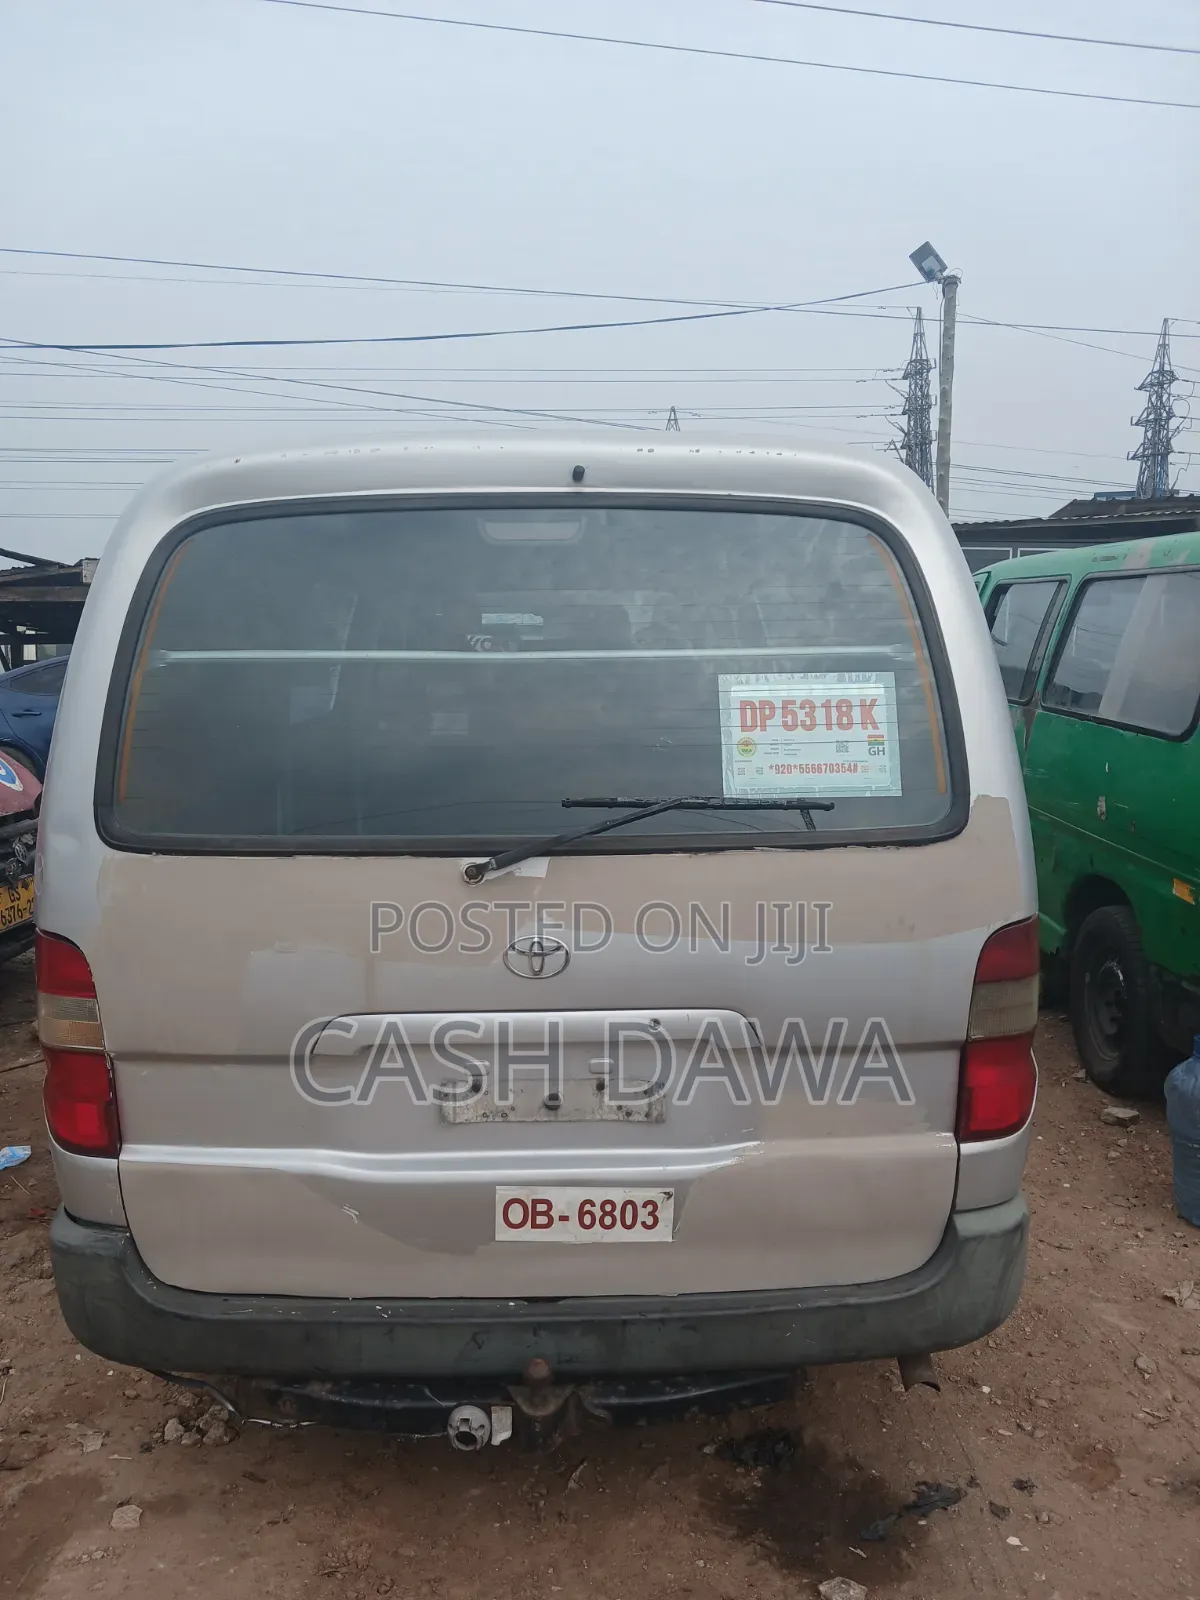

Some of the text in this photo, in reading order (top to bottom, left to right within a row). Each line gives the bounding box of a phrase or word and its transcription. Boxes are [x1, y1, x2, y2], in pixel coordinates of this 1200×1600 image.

[739, 698, 880, 733] DP 5318 K
[868, 746, 886, 756] GH
[0, 897, 34, 926] 6376-2
